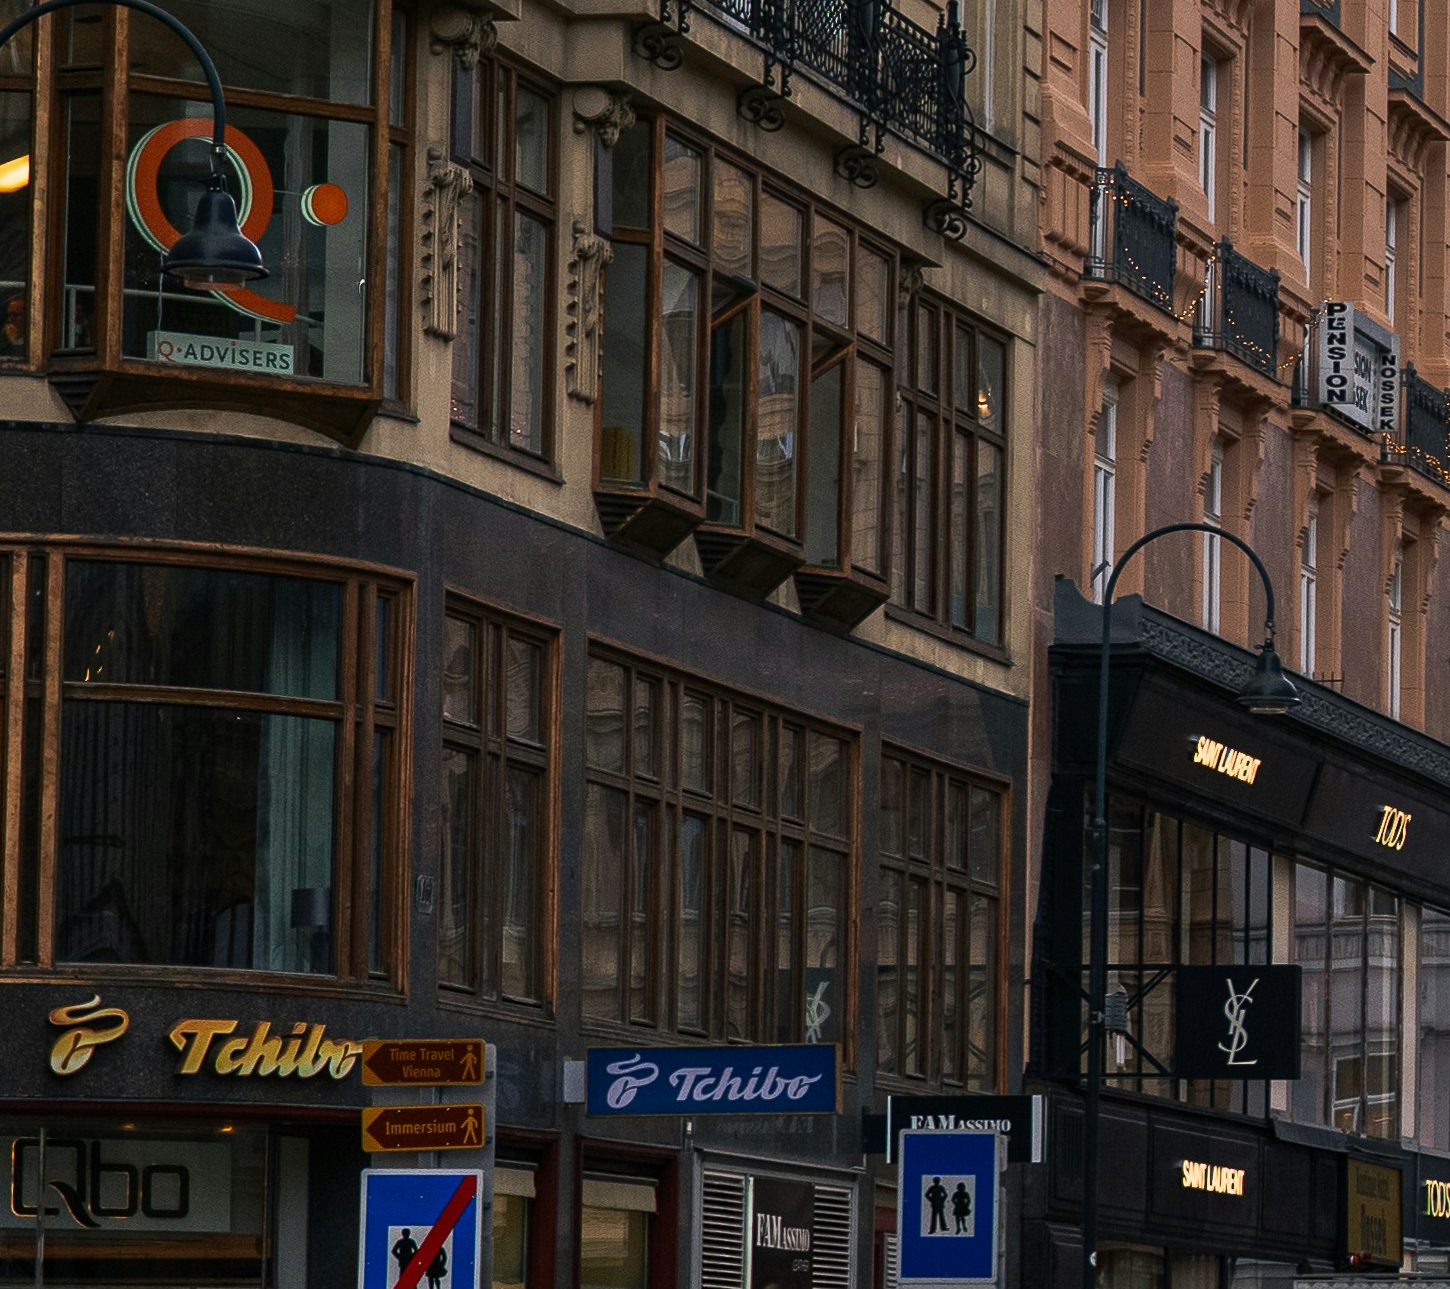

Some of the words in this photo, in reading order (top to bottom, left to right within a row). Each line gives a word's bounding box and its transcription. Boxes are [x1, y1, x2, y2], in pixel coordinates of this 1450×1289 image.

[1326, 302, 1348, 402] PENSION
[1380, 355, 1397, 430] NOSSEK
[1193, 735, 1224, 770] SAINT
[1217, 746, 1263, 785] LAURENT
[168, 1018, 363, 1080] Tchibo
[389, 1047, 416, 1061] Time
[419, 1047, 455, 1061] Travel
[402, 1065, 441, 1078] Vienna
[669, 1066, 822, 1101] Tchibo
[385, 1119, 457, 1135] Immersium
[12, 1137, 189, 1228] Qbo
[1182, 1159, 1207, 1191] SAINT
[1206, 1165, 1246, 1197] LAURENT
